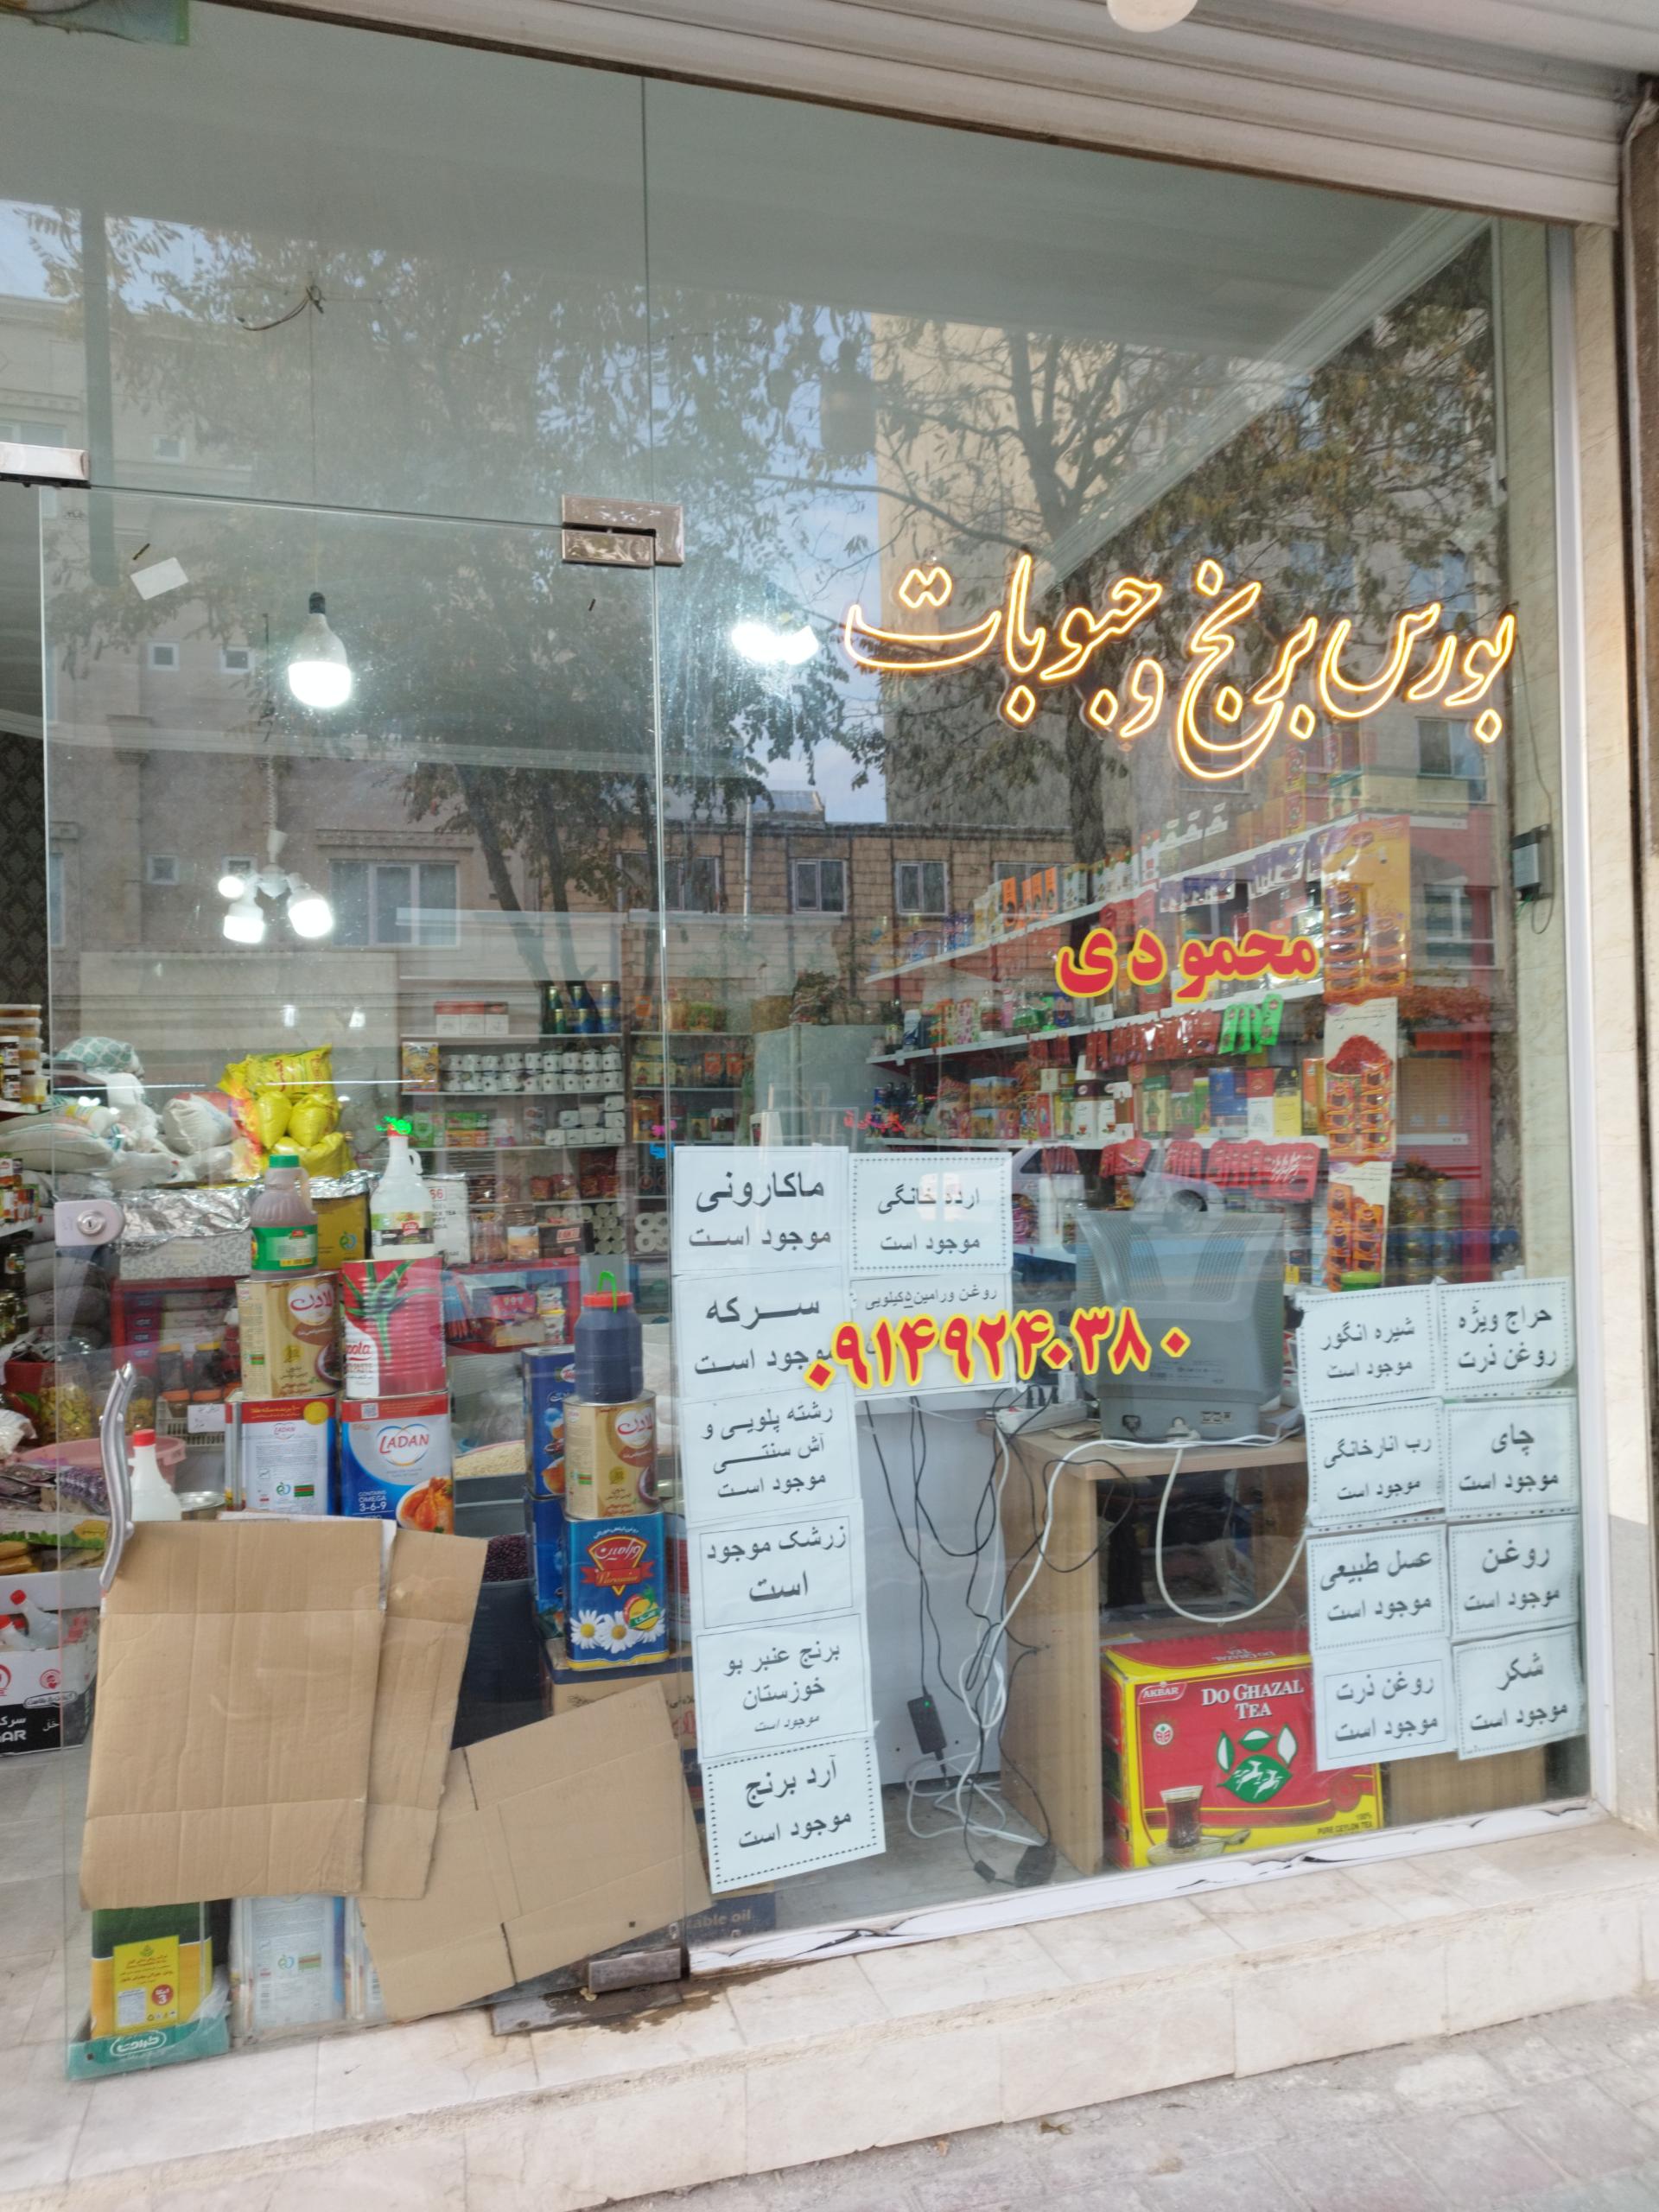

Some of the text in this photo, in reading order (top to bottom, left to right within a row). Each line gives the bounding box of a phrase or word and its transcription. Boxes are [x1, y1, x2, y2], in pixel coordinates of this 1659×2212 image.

[843, 553, 1516, 779] بورس برنج و حبوبات
[1055, 927, 1321, 1004] محمودی
[696, 1170, 824, 1212] ماکارونی
[877, 1183, 937, 1214] خانگی
[689, 1225, 831, 1252] موجود است
[880, 1234, 981, 1255] موجود است
[958, 1284, 998, 1301] روغن
[706, 1295, 820, 1331] سرکه
[1458, 1300, 1553, 1334] حراج ویژه
[804, 1306, 1192, 1392] ۰۹۱۴۹۲۴۰۳۸۰
[1320, 1316, 1415, 1351] شیره انگور
[694, 1347, 755, 1375] است
[1326, 1360, 1413, 1379] موجود است
[1458, 1341, 1557, 1373] روغن ذرت
[701, 1401, 833, 1440] رشته پلویی و
[378, 1433, 429, 1454] LADAN
[713, 1433, 825, 1474] آش سنتی
[1405, 1437, 1432, 1453] رب
[1491, 1421, 1535, 1457] چای
[717, 1473, 826, 1498] موجود است
[1337, 1480, 1421, 1501] موجود است
[1459, 1471, 1559, 1493] موجود است
[359, 1503, 387, 1512] 3-6-9
[707, 1523, 848, 1564] زرشک موجود
[1482, 1539, 1551, 1573] روغن
[1320, 1549, 1433, 1591] عسل طبیعی
[748, 1570, 809, 1603] است
[1464, 1589, 1560, 1611] موجود است
[1327, 1597, 1432, 1621] موجود است
[723, 1640, 840, 1676] برنج عنبر بو
[1495, 1651, 1544, 1691] شکر
[742, 1677, 825, 1710] خوزستان
[1142, 1686, 1179, 1699] AKBAR
[1336, 1671, 1434, 1704] روغن ذرت
[0, 1715, 27, 1728] سرک
[754, 1715, 820, 1732] موجود است
[1335, 1716, 1439, 1742] موجود است
[1470, 1703, 1568, 1731] موجود است
[744, 1755, 837, 1808] آرد برنج
[738, 1810, 853, 1849] موجود است
